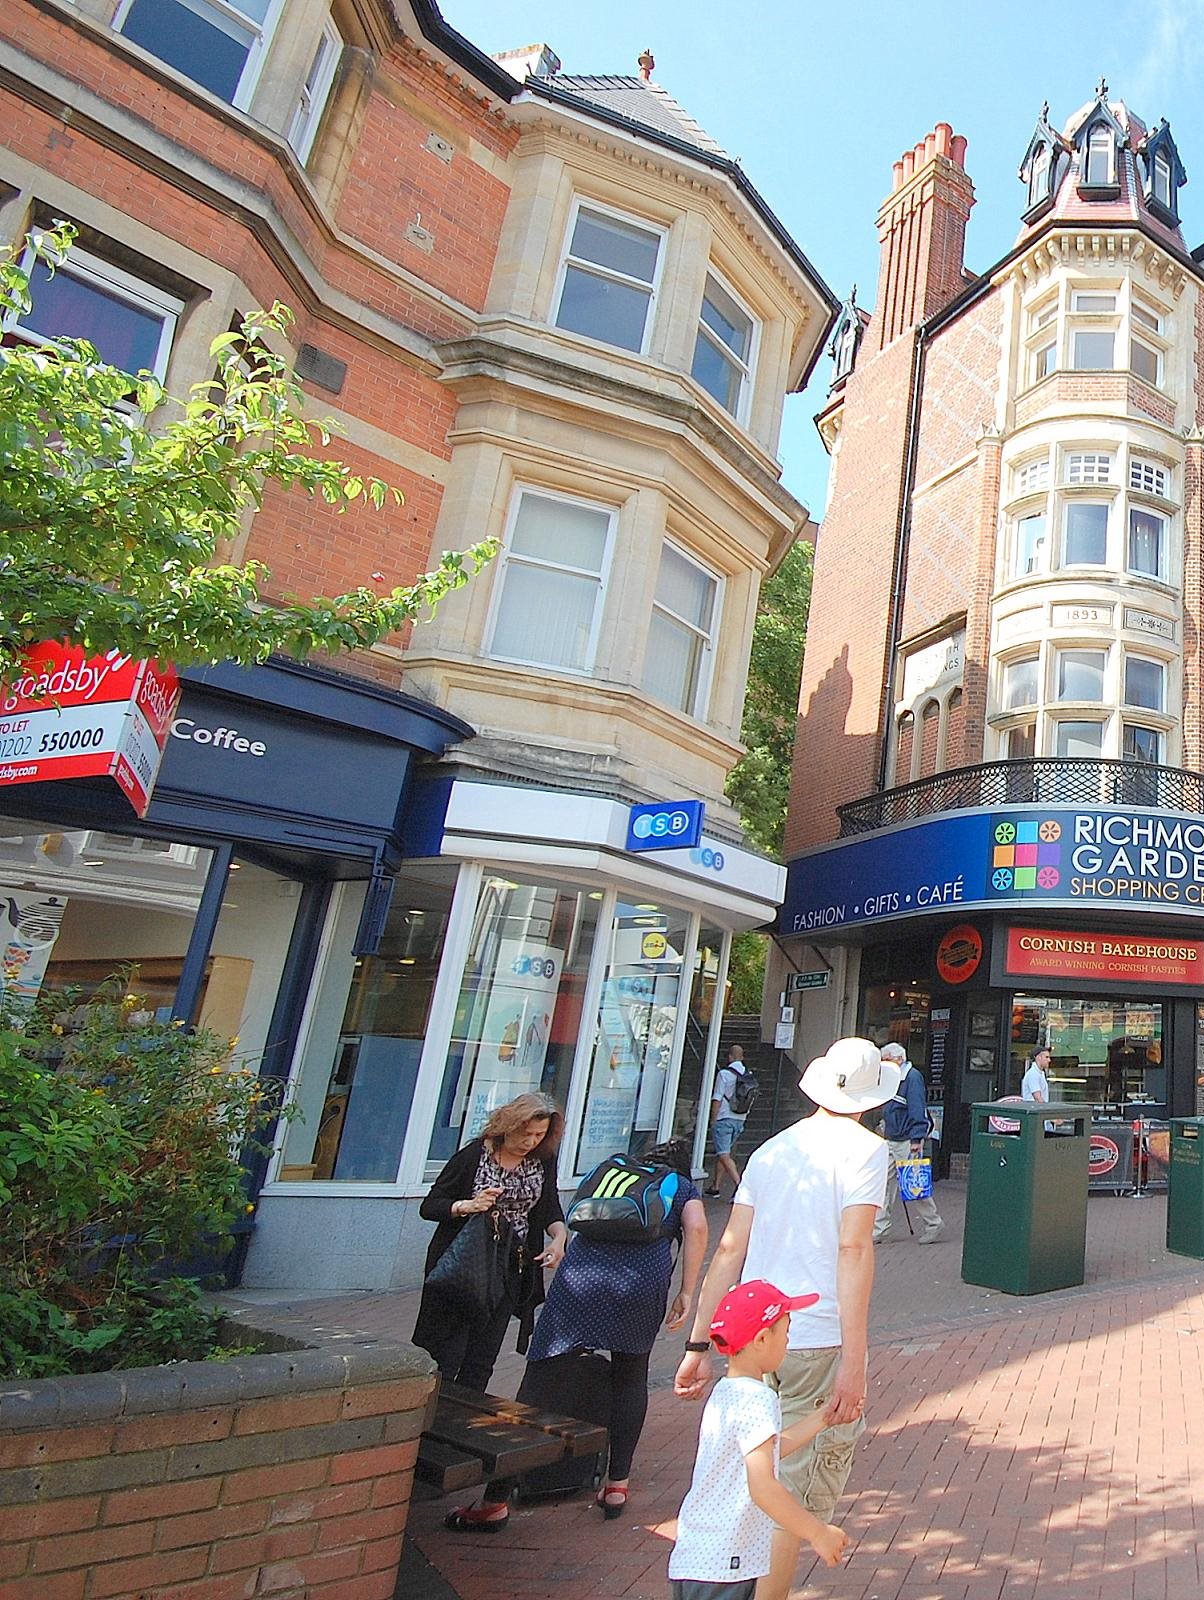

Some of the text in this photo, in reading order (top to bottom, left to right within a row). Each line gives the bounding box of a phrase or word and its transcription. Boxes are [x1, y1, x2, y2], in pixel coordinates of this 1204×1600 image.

[1067, 609, 1098, 620] 1893
[12, 720, 29, 732] LET
[170, 718, 267, 756] Coffee
[0, 728, 104, 757] 1202 550000
[637, 814, 685, 835] TSB
[1070, 877, 1179, 900] SHOPPING
[794, 875, 963, 931] FASHION GIFTS CAFÉ
[1019, 936, 1197, 961] CORNISH BAKEHOUSE
[1029, 957, 1062, 967] AWARD
[1066, 959, 1104, 970] WINNING
[1108, 962, 1148, 973] CORNISH
